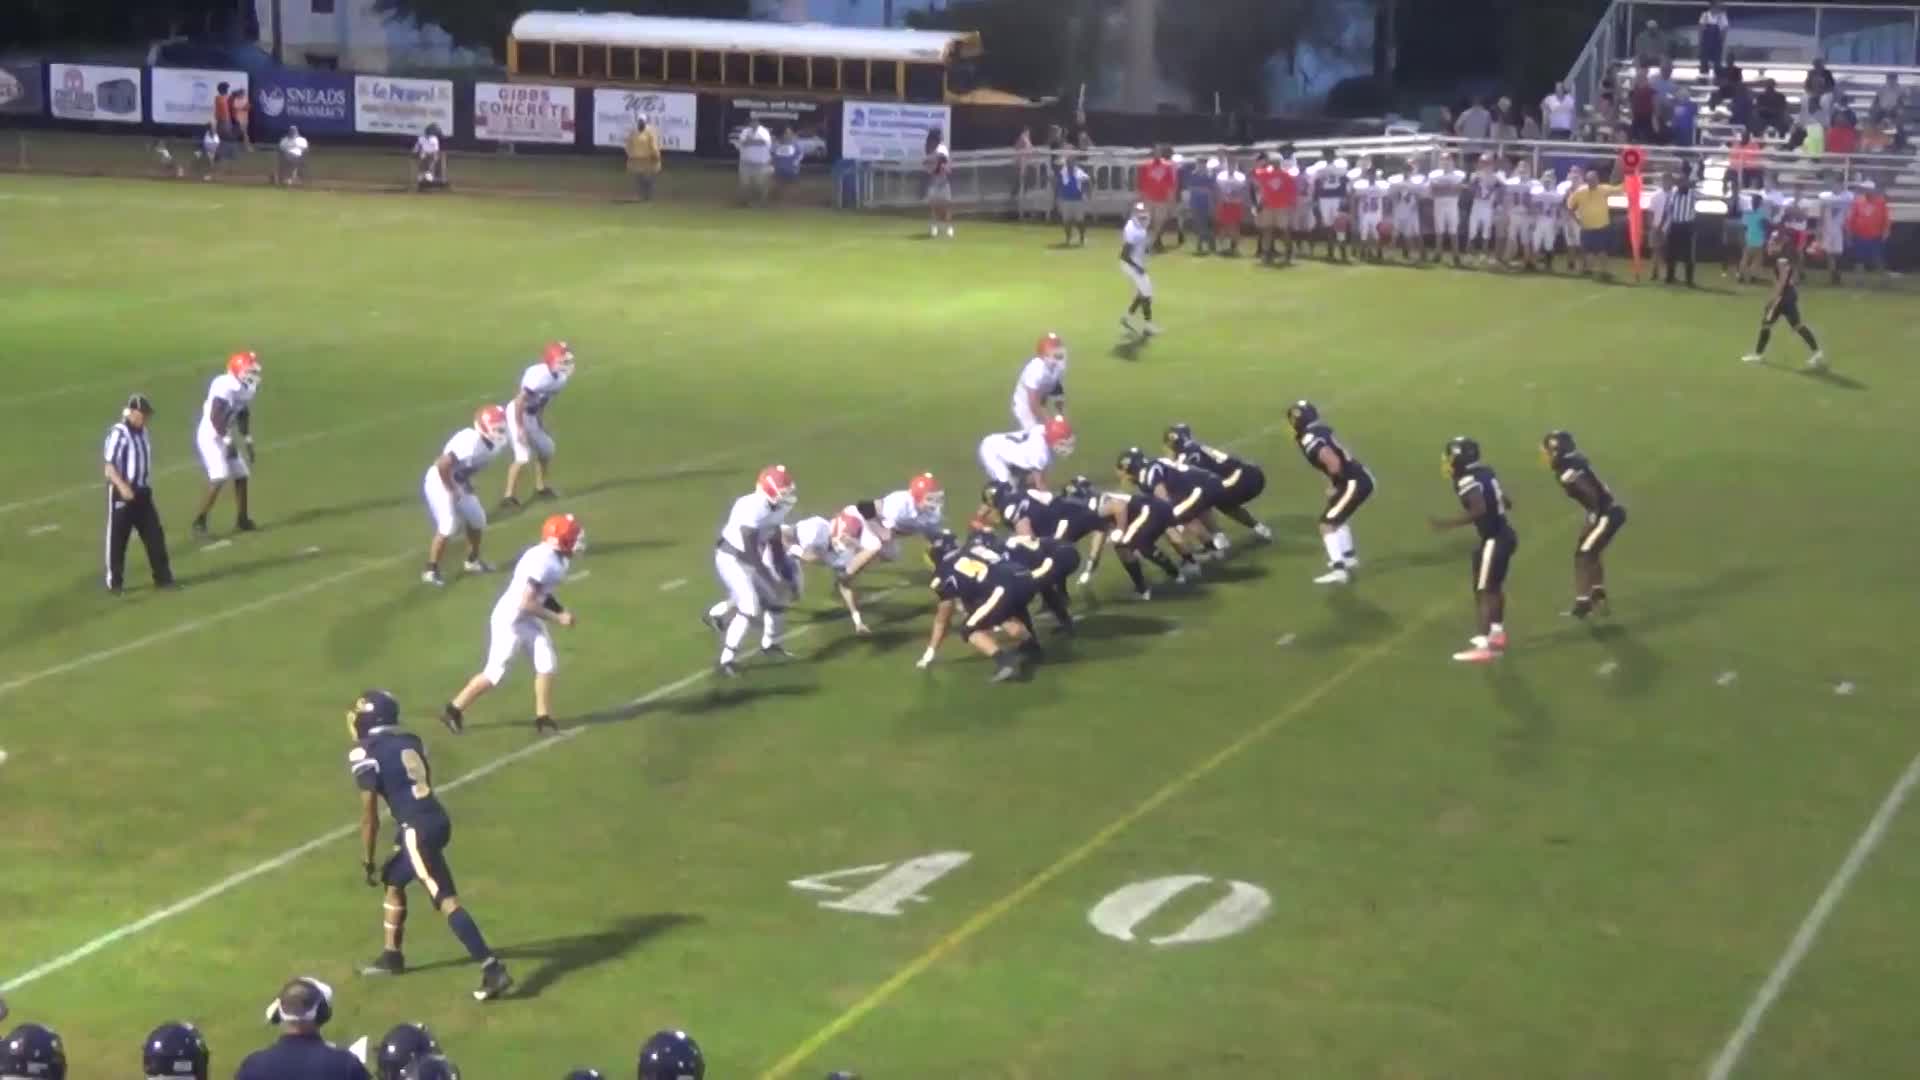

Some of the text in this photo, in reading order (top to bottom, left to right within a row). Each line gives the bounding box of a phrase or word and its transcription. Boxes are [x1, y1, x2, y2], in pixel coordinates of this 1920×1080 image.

[286, 87, 345, 105] SNEADS
[498, 87, 550, 102] GIBBS
[478, 101, 571, 118] CONCRETE
